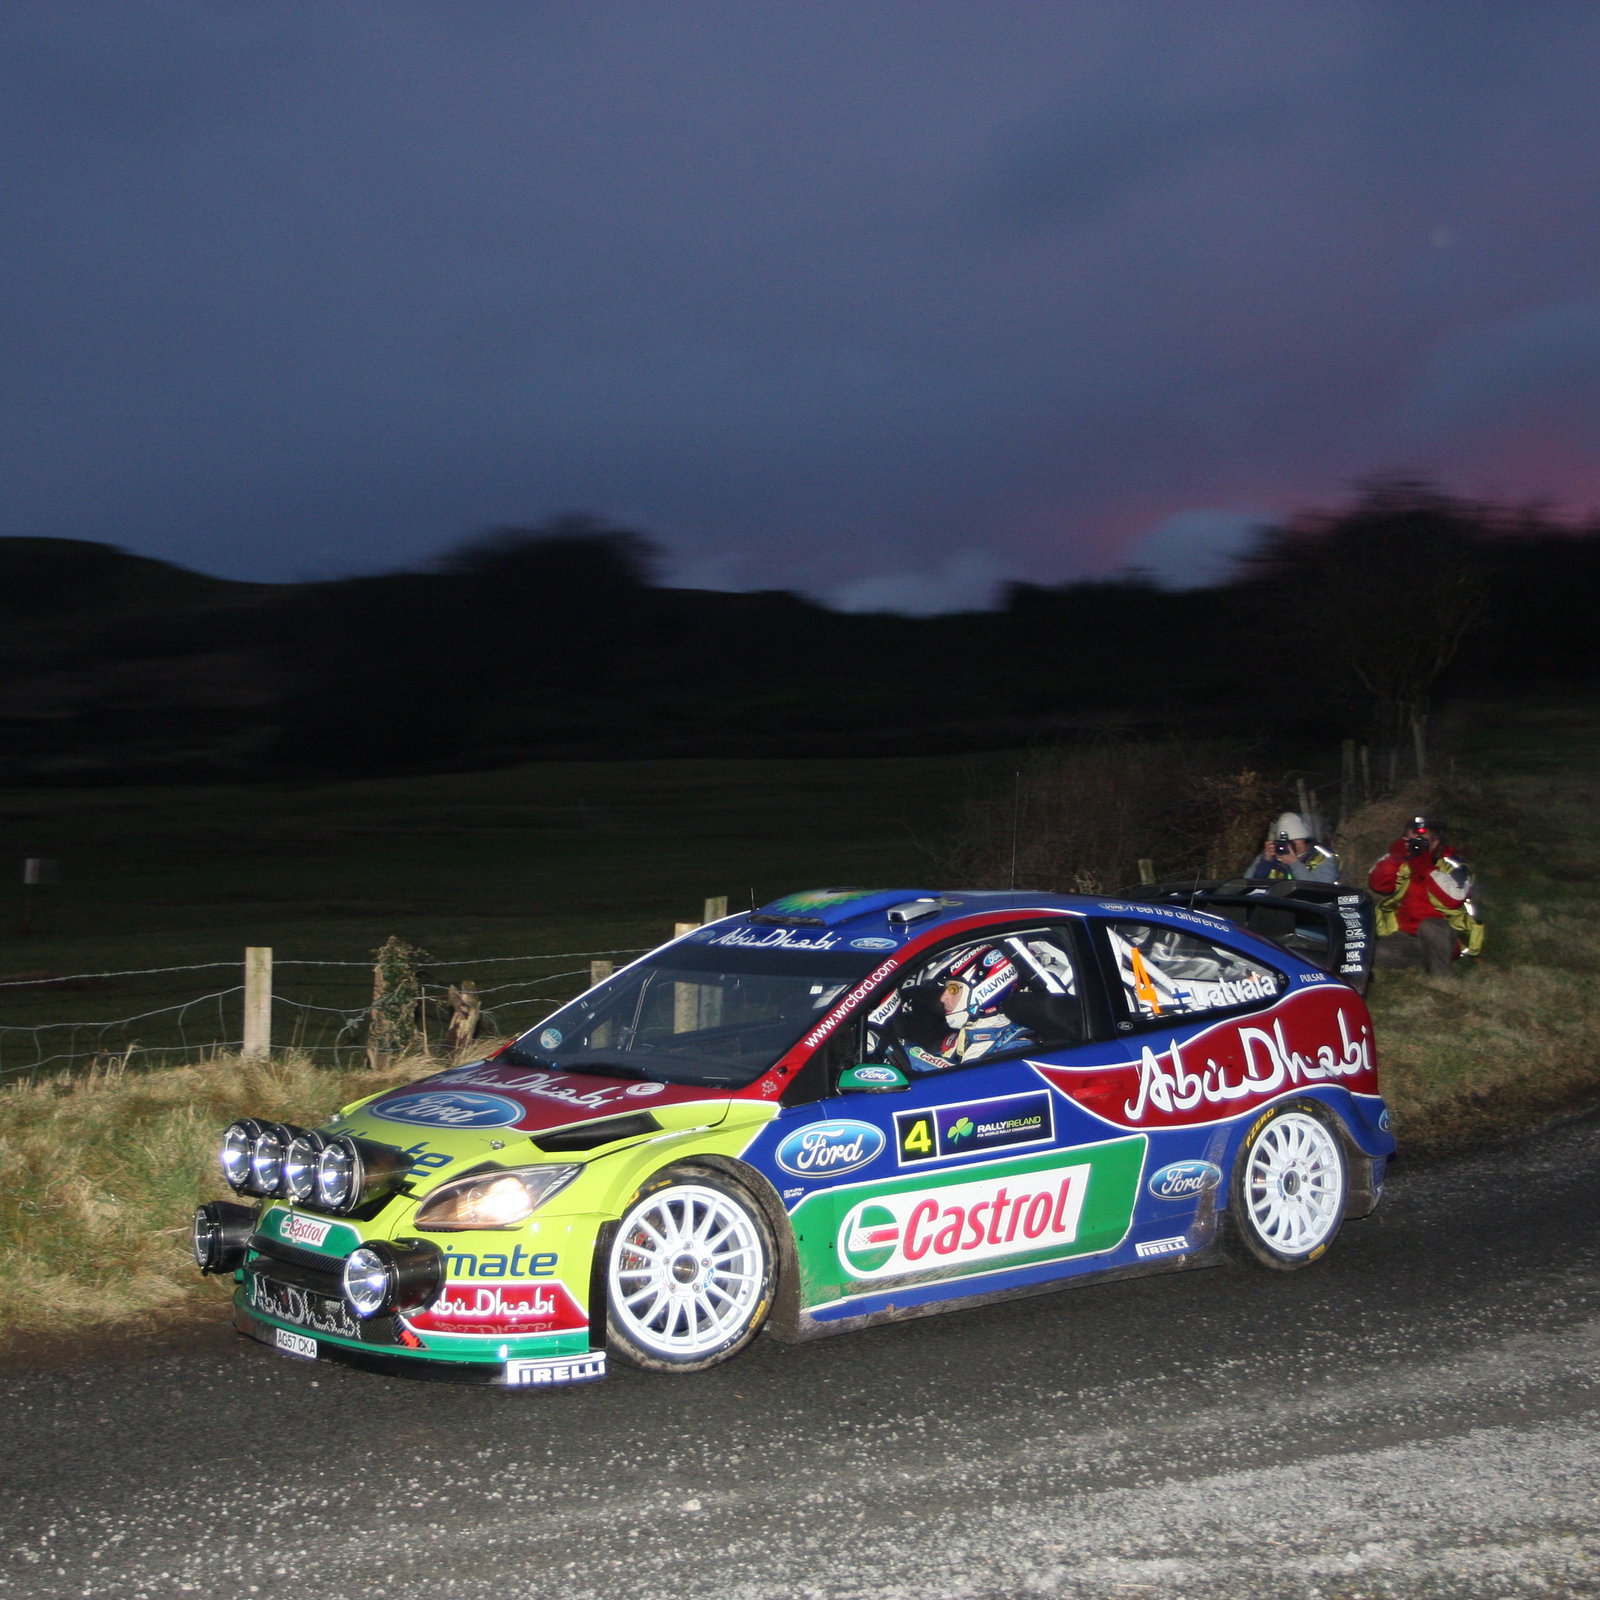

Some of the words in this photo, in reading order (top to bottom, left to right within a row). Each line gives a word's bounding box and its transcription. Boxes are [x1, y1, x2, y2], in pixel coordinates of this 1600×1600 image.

[857, 938, 888, 949] Ford
[1131, 947, 1162, 1014] 4
[1190, 971, 1277, 1009] Latvala
[804, 959, 899, 1048] www.wrcford.com
[860, 1069, 889, 1080] Ford
[385, 1095, 500, 1123] Ford
[797, 1128, 864, 1169] Ford
[904, 1120, 932, 1153] 4
[1162, 1167, 1207, 1194] Ford
[289, 1218, 327, 1243] Castrol
[903, 1176, 1072, 1261] Castrol
[1135, 1236, 1189, 1257] PIRELLI
[277, 1331, 297, 1349] AG57
[299, 1338, 316, 1356] CKA
[506, 1351, 607, 1384] PIRELLI
